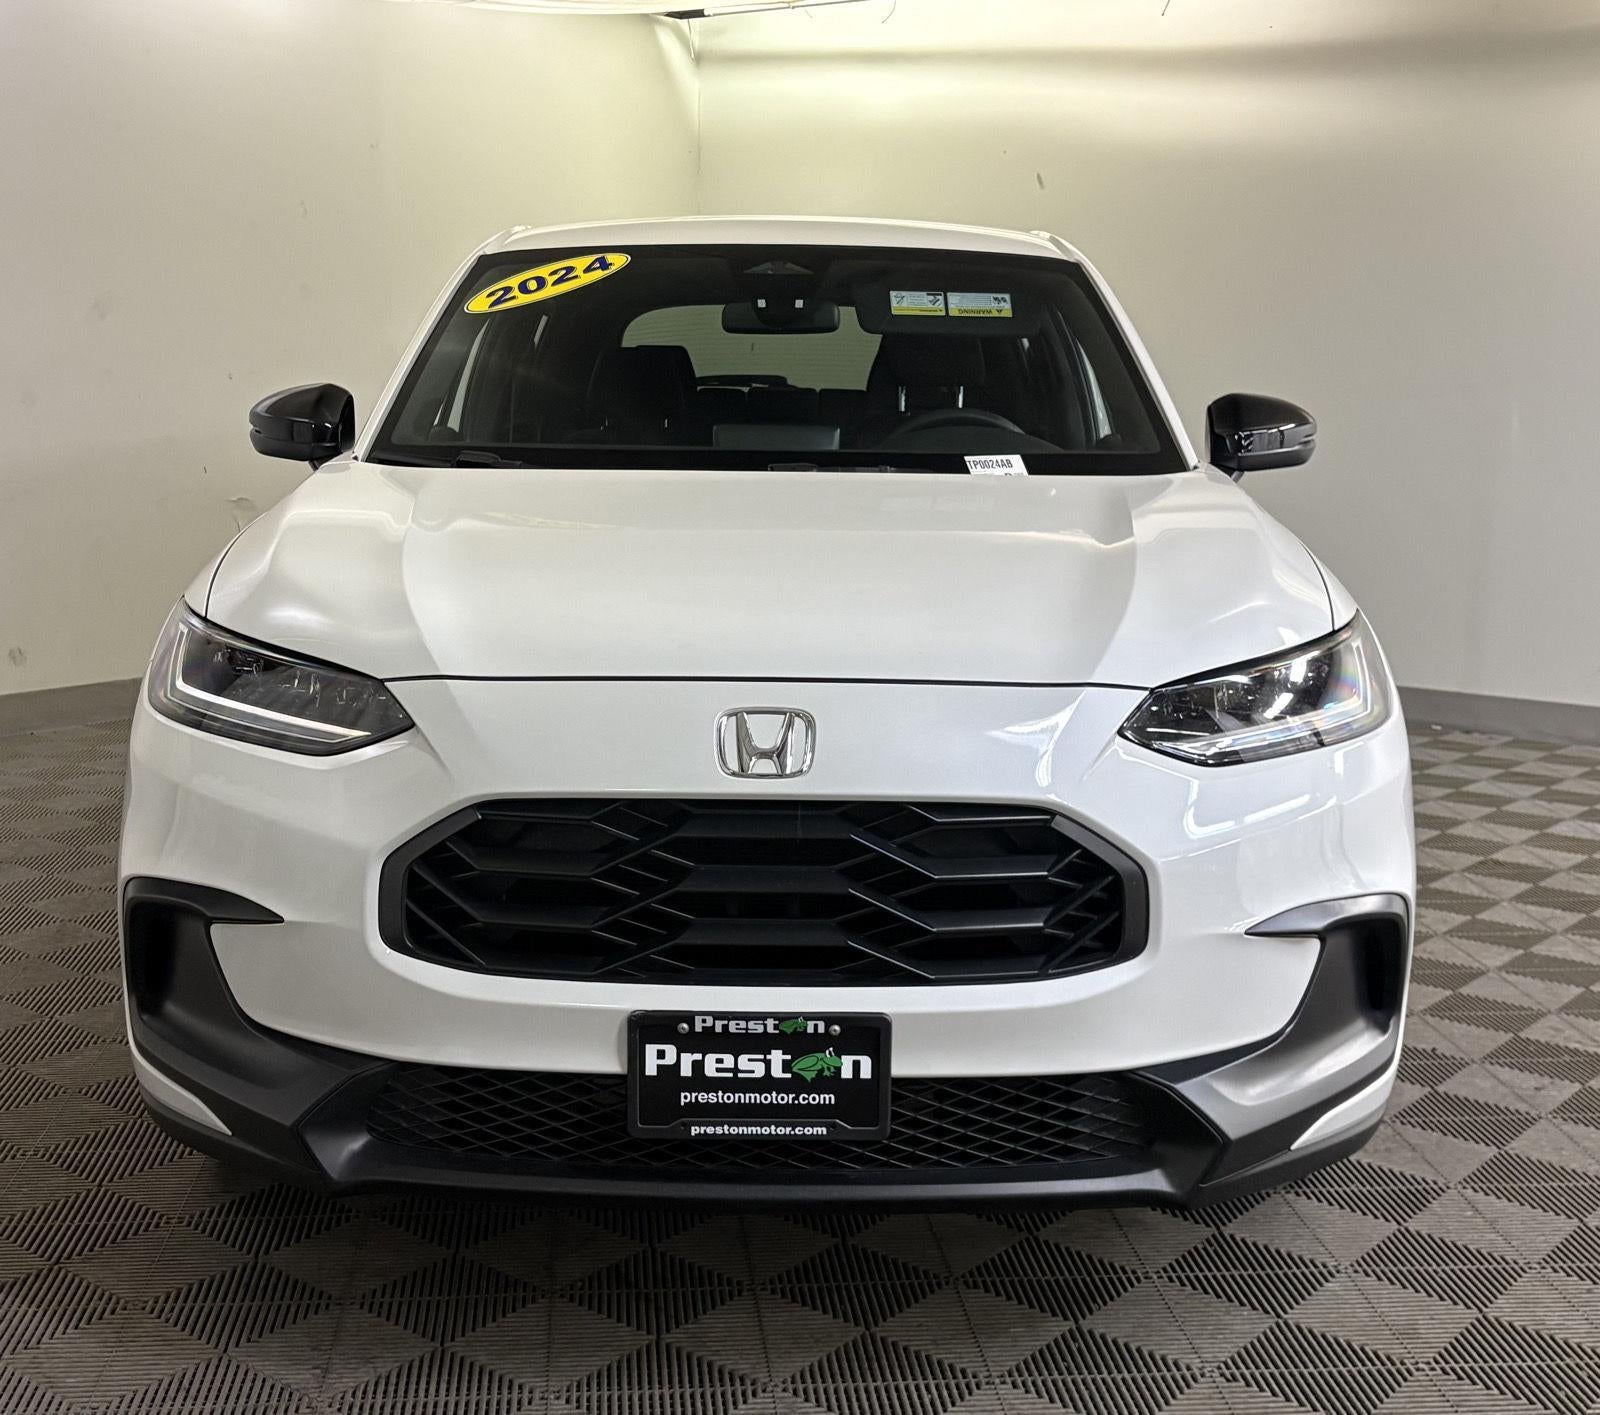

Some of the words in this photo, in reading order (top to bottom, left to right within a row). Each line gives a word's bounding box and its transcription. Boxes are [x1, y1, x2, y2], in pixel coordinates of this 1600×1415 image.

[486, 255, 614, 309] 2024
[680, 1090, 835, 1106] prestonmotor.com
[690, 1123, 827, 1136] prestonmotor.com
